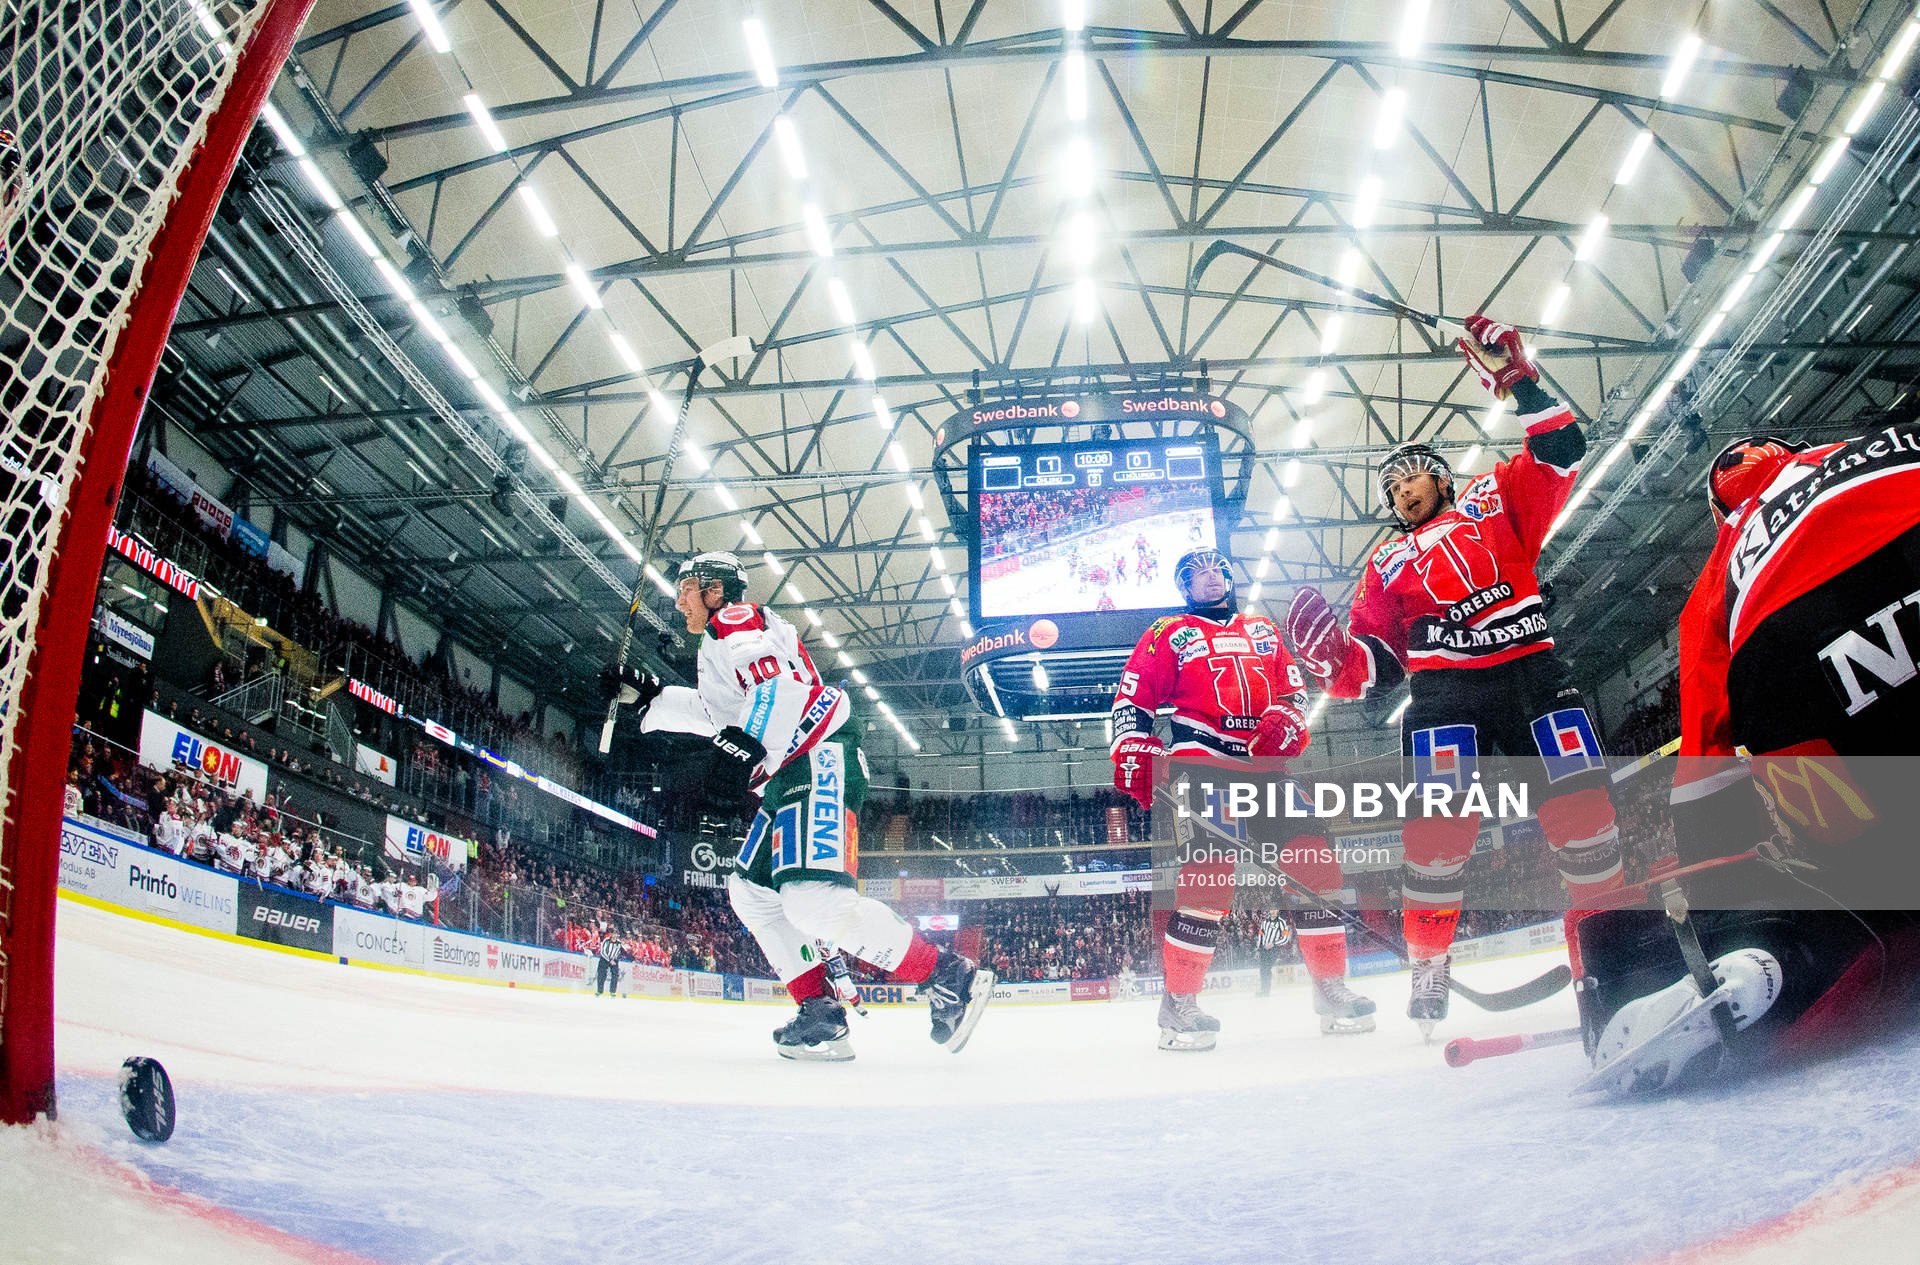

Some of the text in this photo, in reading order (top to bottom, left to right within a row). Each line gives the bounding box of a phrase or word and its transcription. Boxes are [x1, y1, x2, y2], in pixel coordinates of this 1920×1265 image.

[973, 404, 1058, 425] Swedbank
[1122, 398, 1209, 414] Swedbank
[1132, 455, 1141, 467] 0
[1465, 495, 1501, 519] ELON
[1450, 585, 1512, 622] ÖREBRO
[1426, 612, 1548, 648] MALMBERGS
[960, 630, 1025, 664] Swedbank
[1817, 590, 1920, 717] N
[749, 655, 781, 686] 10
[1120, 671, 1140, 697] 5
[810, 686, 841, 725] SKF
[1226, 716, 1261, 729] ÖREB
[171, 731, 242, 786] ELON
[714, 734, 752, 762] UER
[812, 771, 839, 862] STENA
[406, 826, 451, 858] ELON
[1340, 832, 1403, 849] Vintergata
[129, 864, 232, 914] Prinfo WELINS
[683, 869, 730, 889] FAMILJ
[252, 905, 321, 934] BAUER
[1177, 921, 1213, 938] TRUCK
[1303, 910, 1333, 921] TRUC
[443, 942, 481, 967] Botrygg
